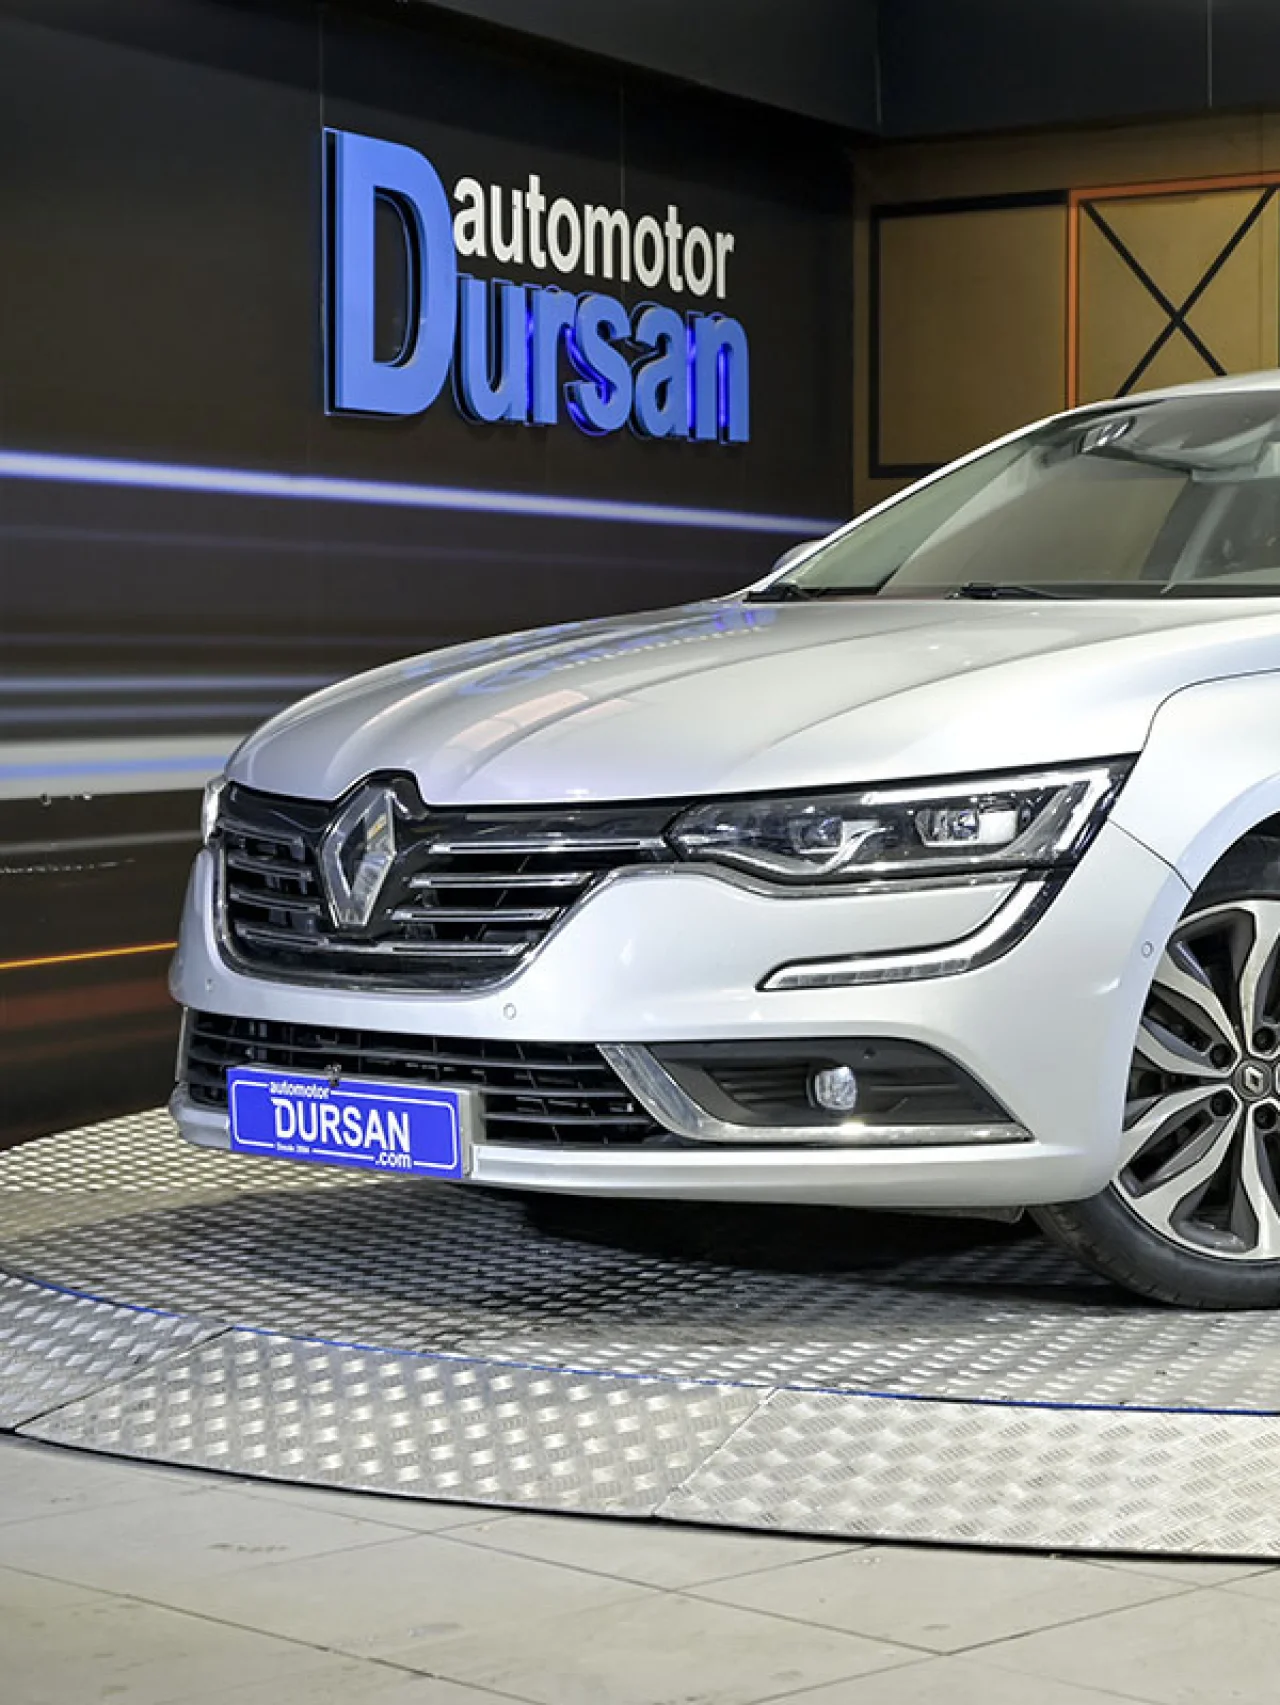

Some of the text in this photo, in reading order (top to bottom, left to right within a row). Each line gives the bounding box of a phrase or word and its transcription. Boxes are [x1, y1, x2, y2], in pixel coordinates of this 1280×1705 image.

[453, 174, 734, 299] automotor
[323, 127, 749, 444] Dursan
[270, 1081, 330, 1099] automotor
[270, 1097, 411, 1152] DURSAN
[374, 1152, 413, 1169] .com
